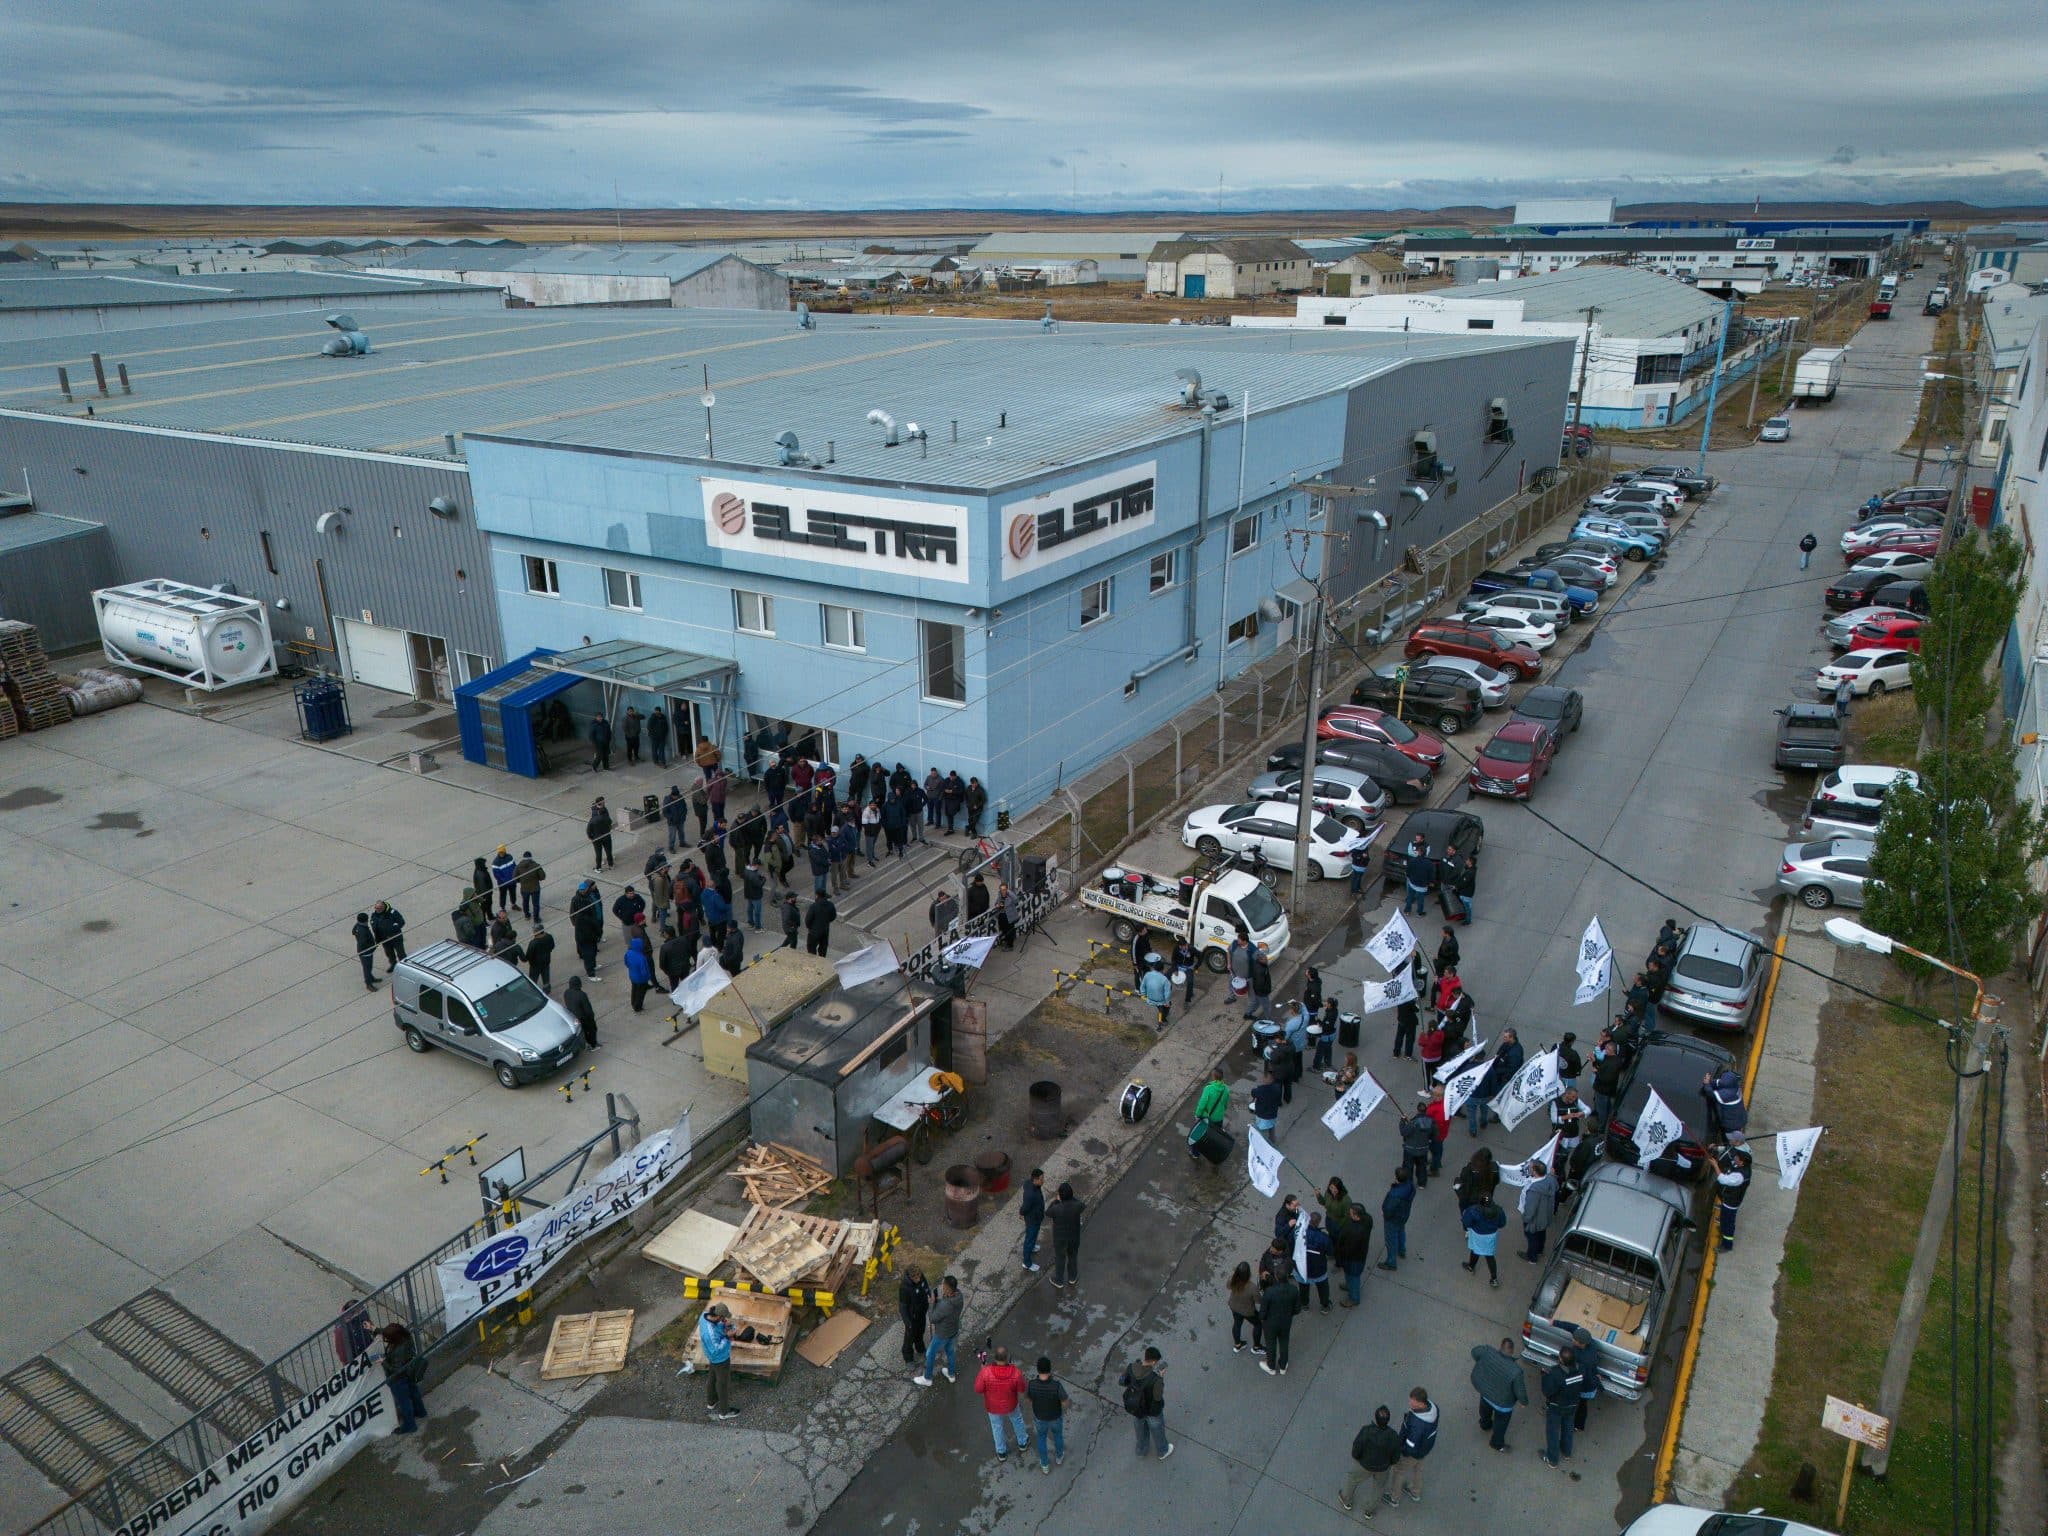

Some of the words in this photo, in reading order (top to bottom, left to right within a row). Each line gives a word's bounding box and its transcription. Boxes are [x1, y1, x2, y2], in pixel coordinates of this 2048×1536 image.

[751, 501, 957, 564] ELECTRA
[1037, 477, 1154, 551] ELECTRA
[480, 1159, 672, 1305] PRESENTE
[227, 1350, 373, 1475] METALURGICA
[237, 1475, 279, 1520] RIO
[287, 1392, 384, 1480] GRANDE
